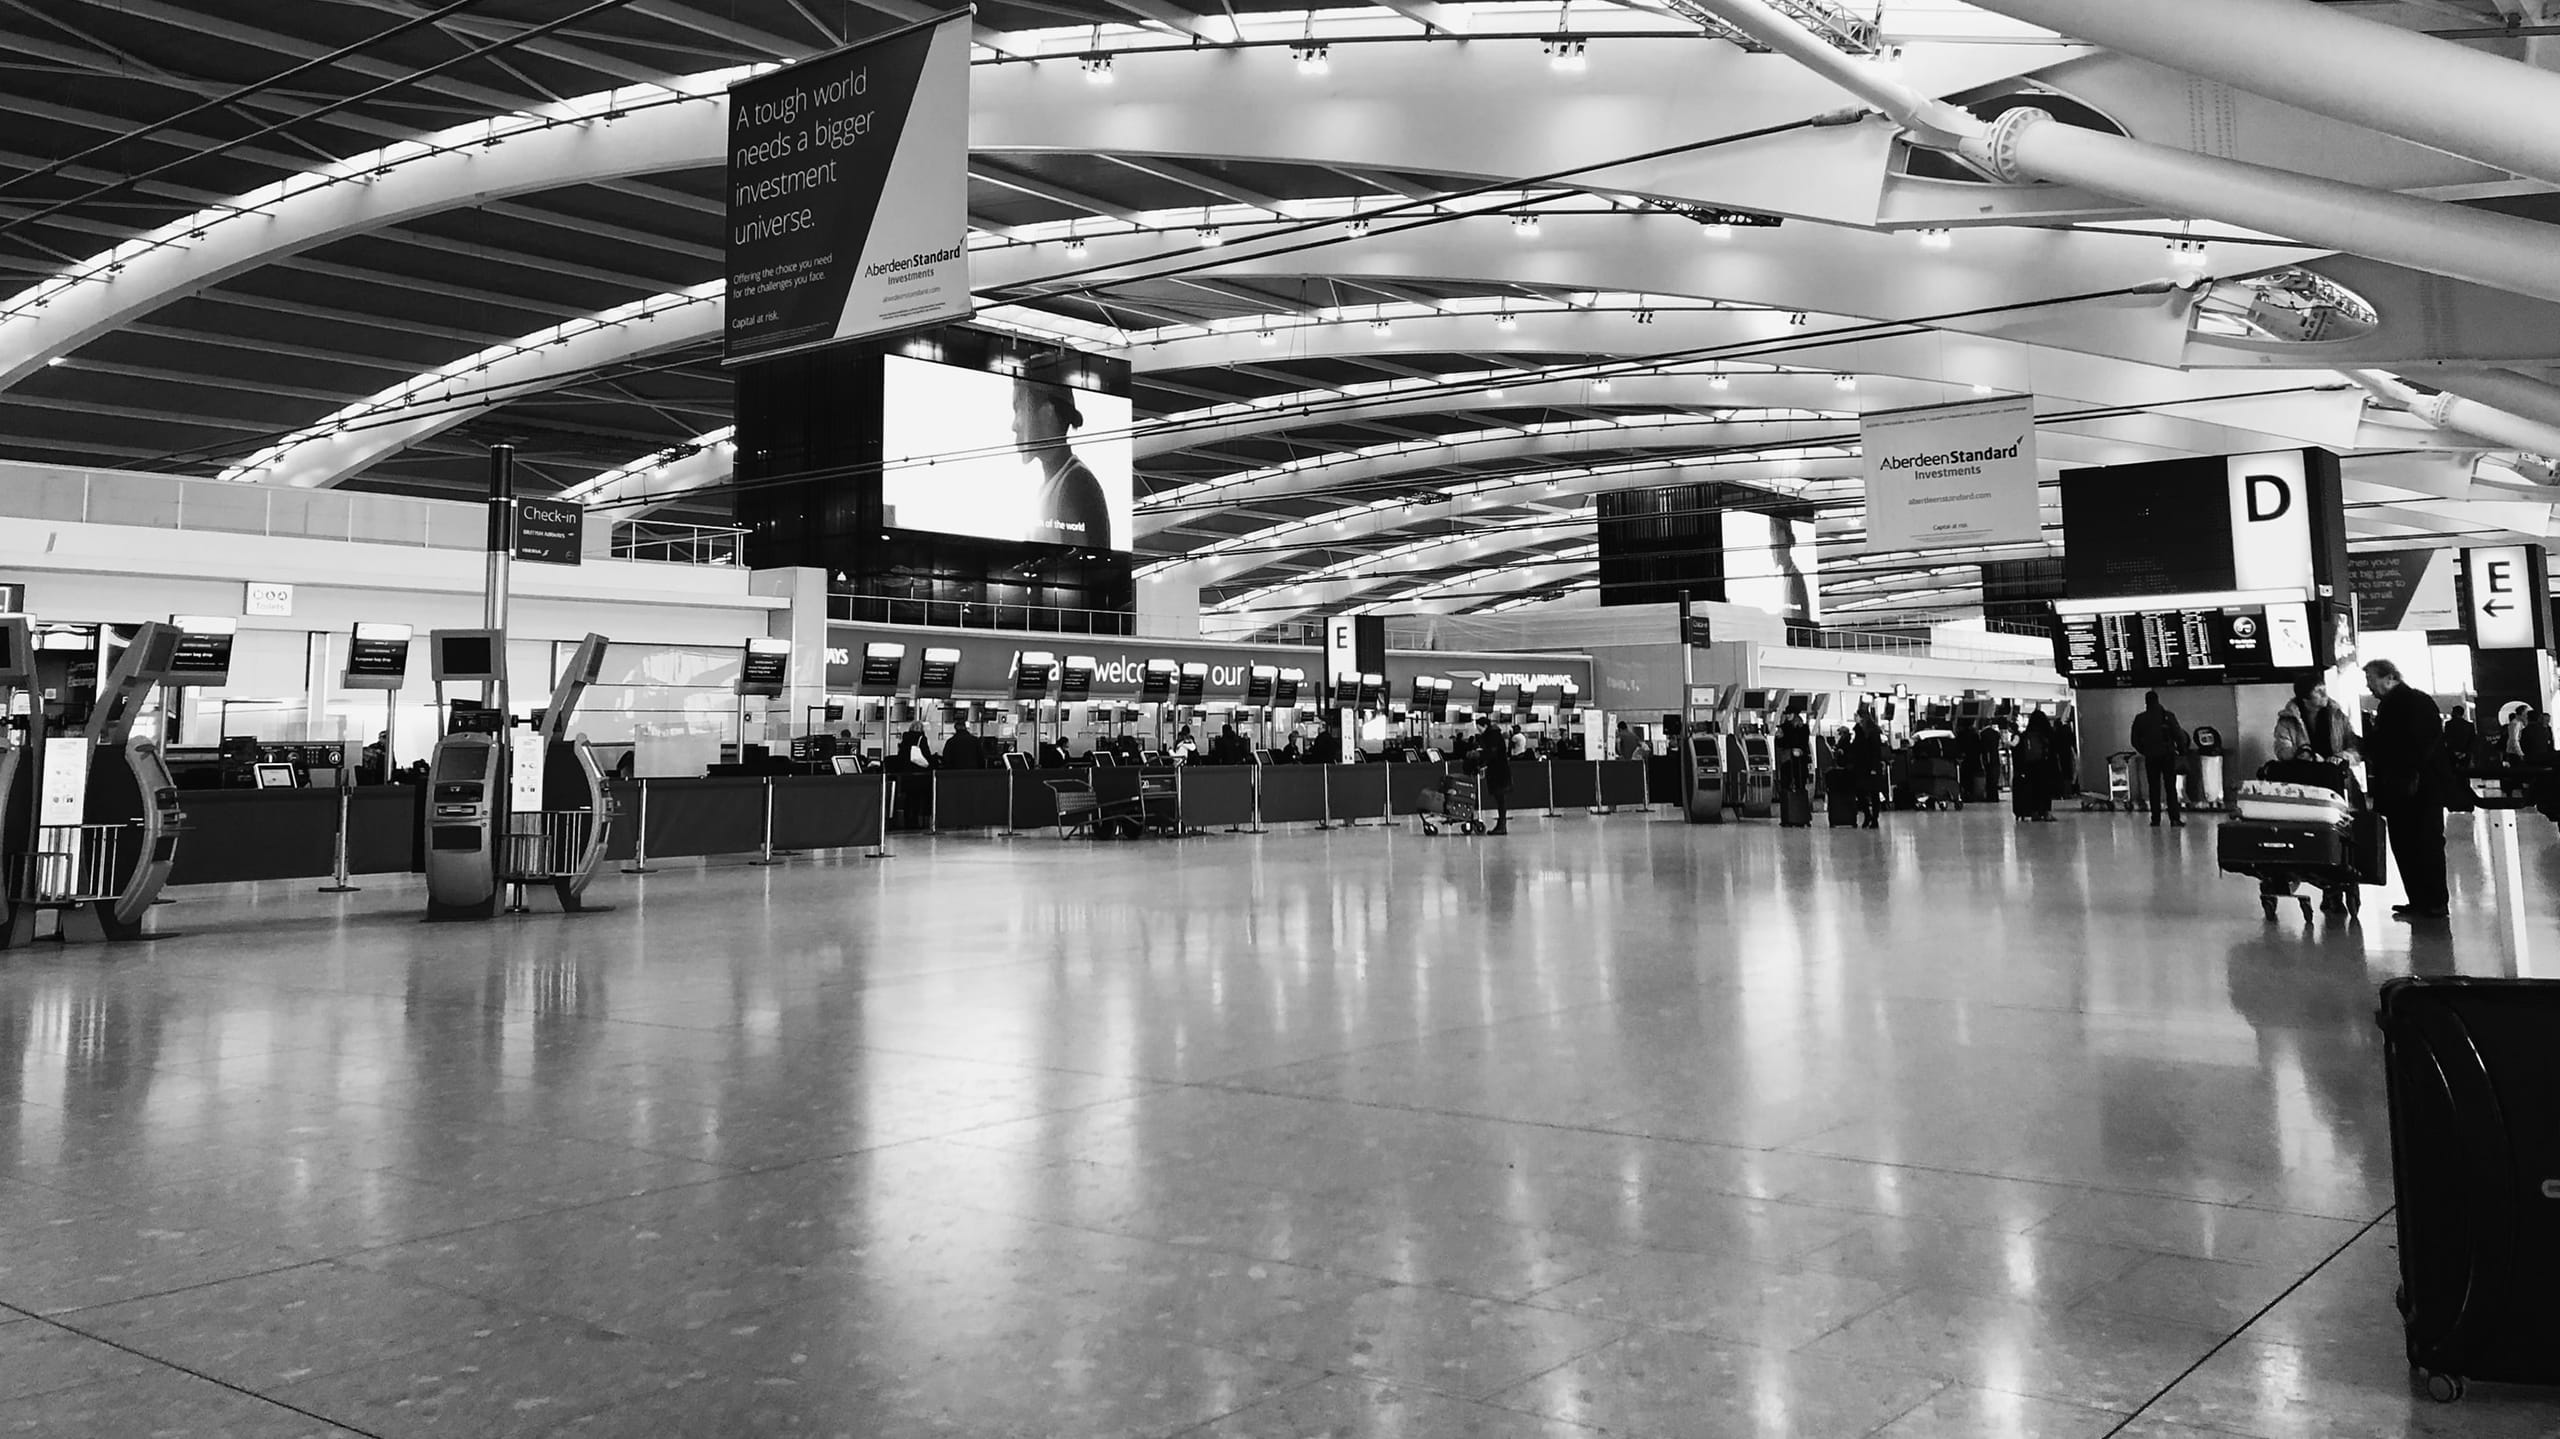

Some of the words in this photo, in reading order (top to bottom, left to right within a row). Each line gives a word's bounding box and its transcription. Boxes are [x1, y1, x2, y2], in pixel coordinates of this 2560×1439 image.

[736, 105, 749, 131] A
[755, 88, 807, 124] tough
[813, 66, 867, 107] world
[737, 131, 791, 168] needs
[797, 131, 808, 151] a
[815, 110, 875, 149] bigger
[736, 159, 837, 207] investment
[735, 208, 815, 245] universe.
[733, 271, 761, 285] Offering
[762, 268, 774, 278] the
[775, 264, 797, 275] choice
[798, 260, 813, 272] you
[814, 252, 833, 266] need
[888, 269, 935, 285] Investments
[733, 288, 743, 299] for
[744, 286, 755, 297] the
[757, 278, 793, 294] challenges
[794, 275, 808, 288] you
[732, 314, 756, 330] Capital
[756, 314, 764, 324] at
[1915, 466, 1982, 480] Investments
[1908, 491, 1992, 505] aberdeenstandard.com
[2245, 474, 2291, 522] D
[523, 505, 577, 524] Check-in
[1054, 519, 1065, 530] the
[1066, 521, 1086, 532] world
[2487, 560, 2513, 593] E
[1336, 626, 1348, 648] E
[826, 647, 849, 665] AYS
[1211, 665, 1245, 686] our
